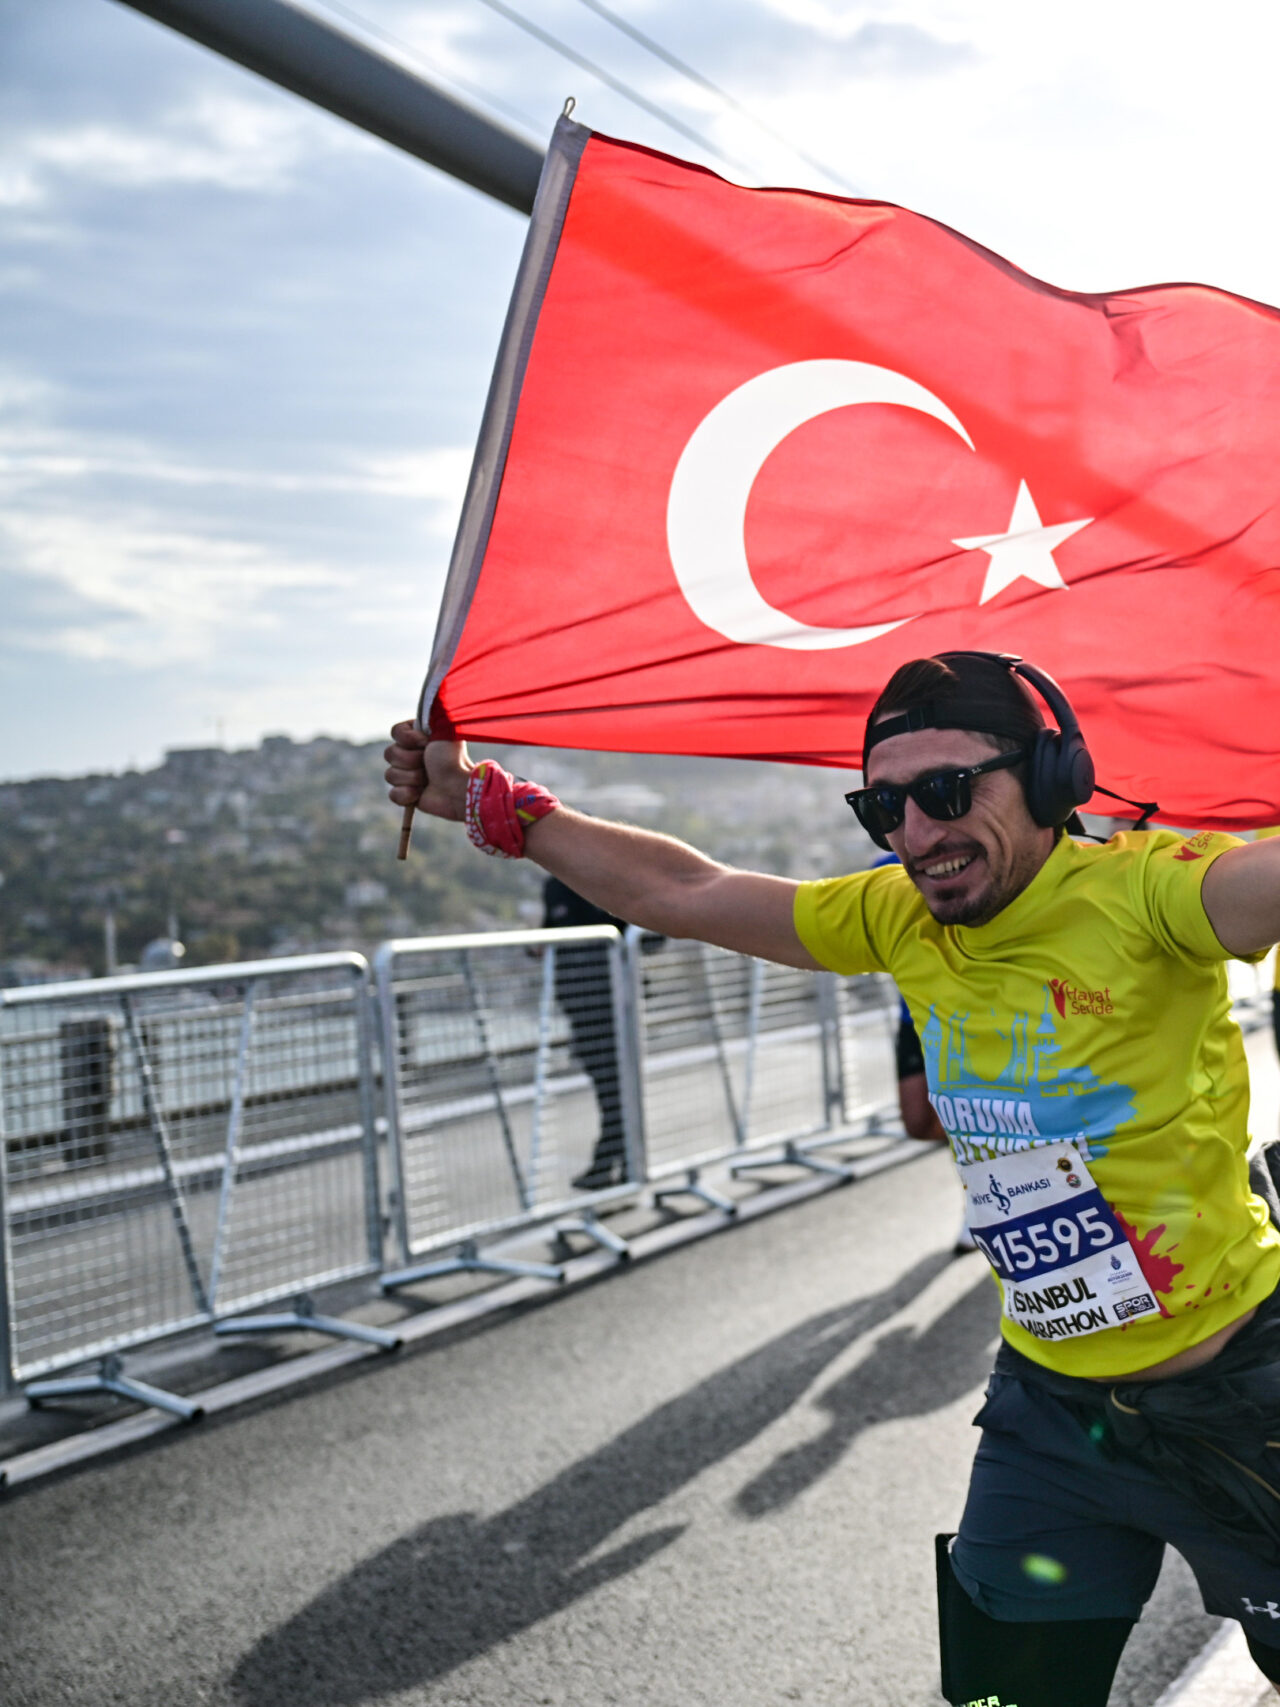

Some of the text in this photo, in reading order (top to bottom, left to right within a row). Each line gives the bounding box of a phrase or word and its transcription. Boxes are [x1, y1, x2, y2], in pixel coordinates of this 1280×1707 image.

[1065, 986, 1111, 1004] Hayat
[1071, 1000, 1114, 1016] Sende
[928, 1092, 1041, 1137] ORUMA
[1006, 1178, 1051, 1197] BANKASI
[1115, 1295, 1150, 1313] SPOR
